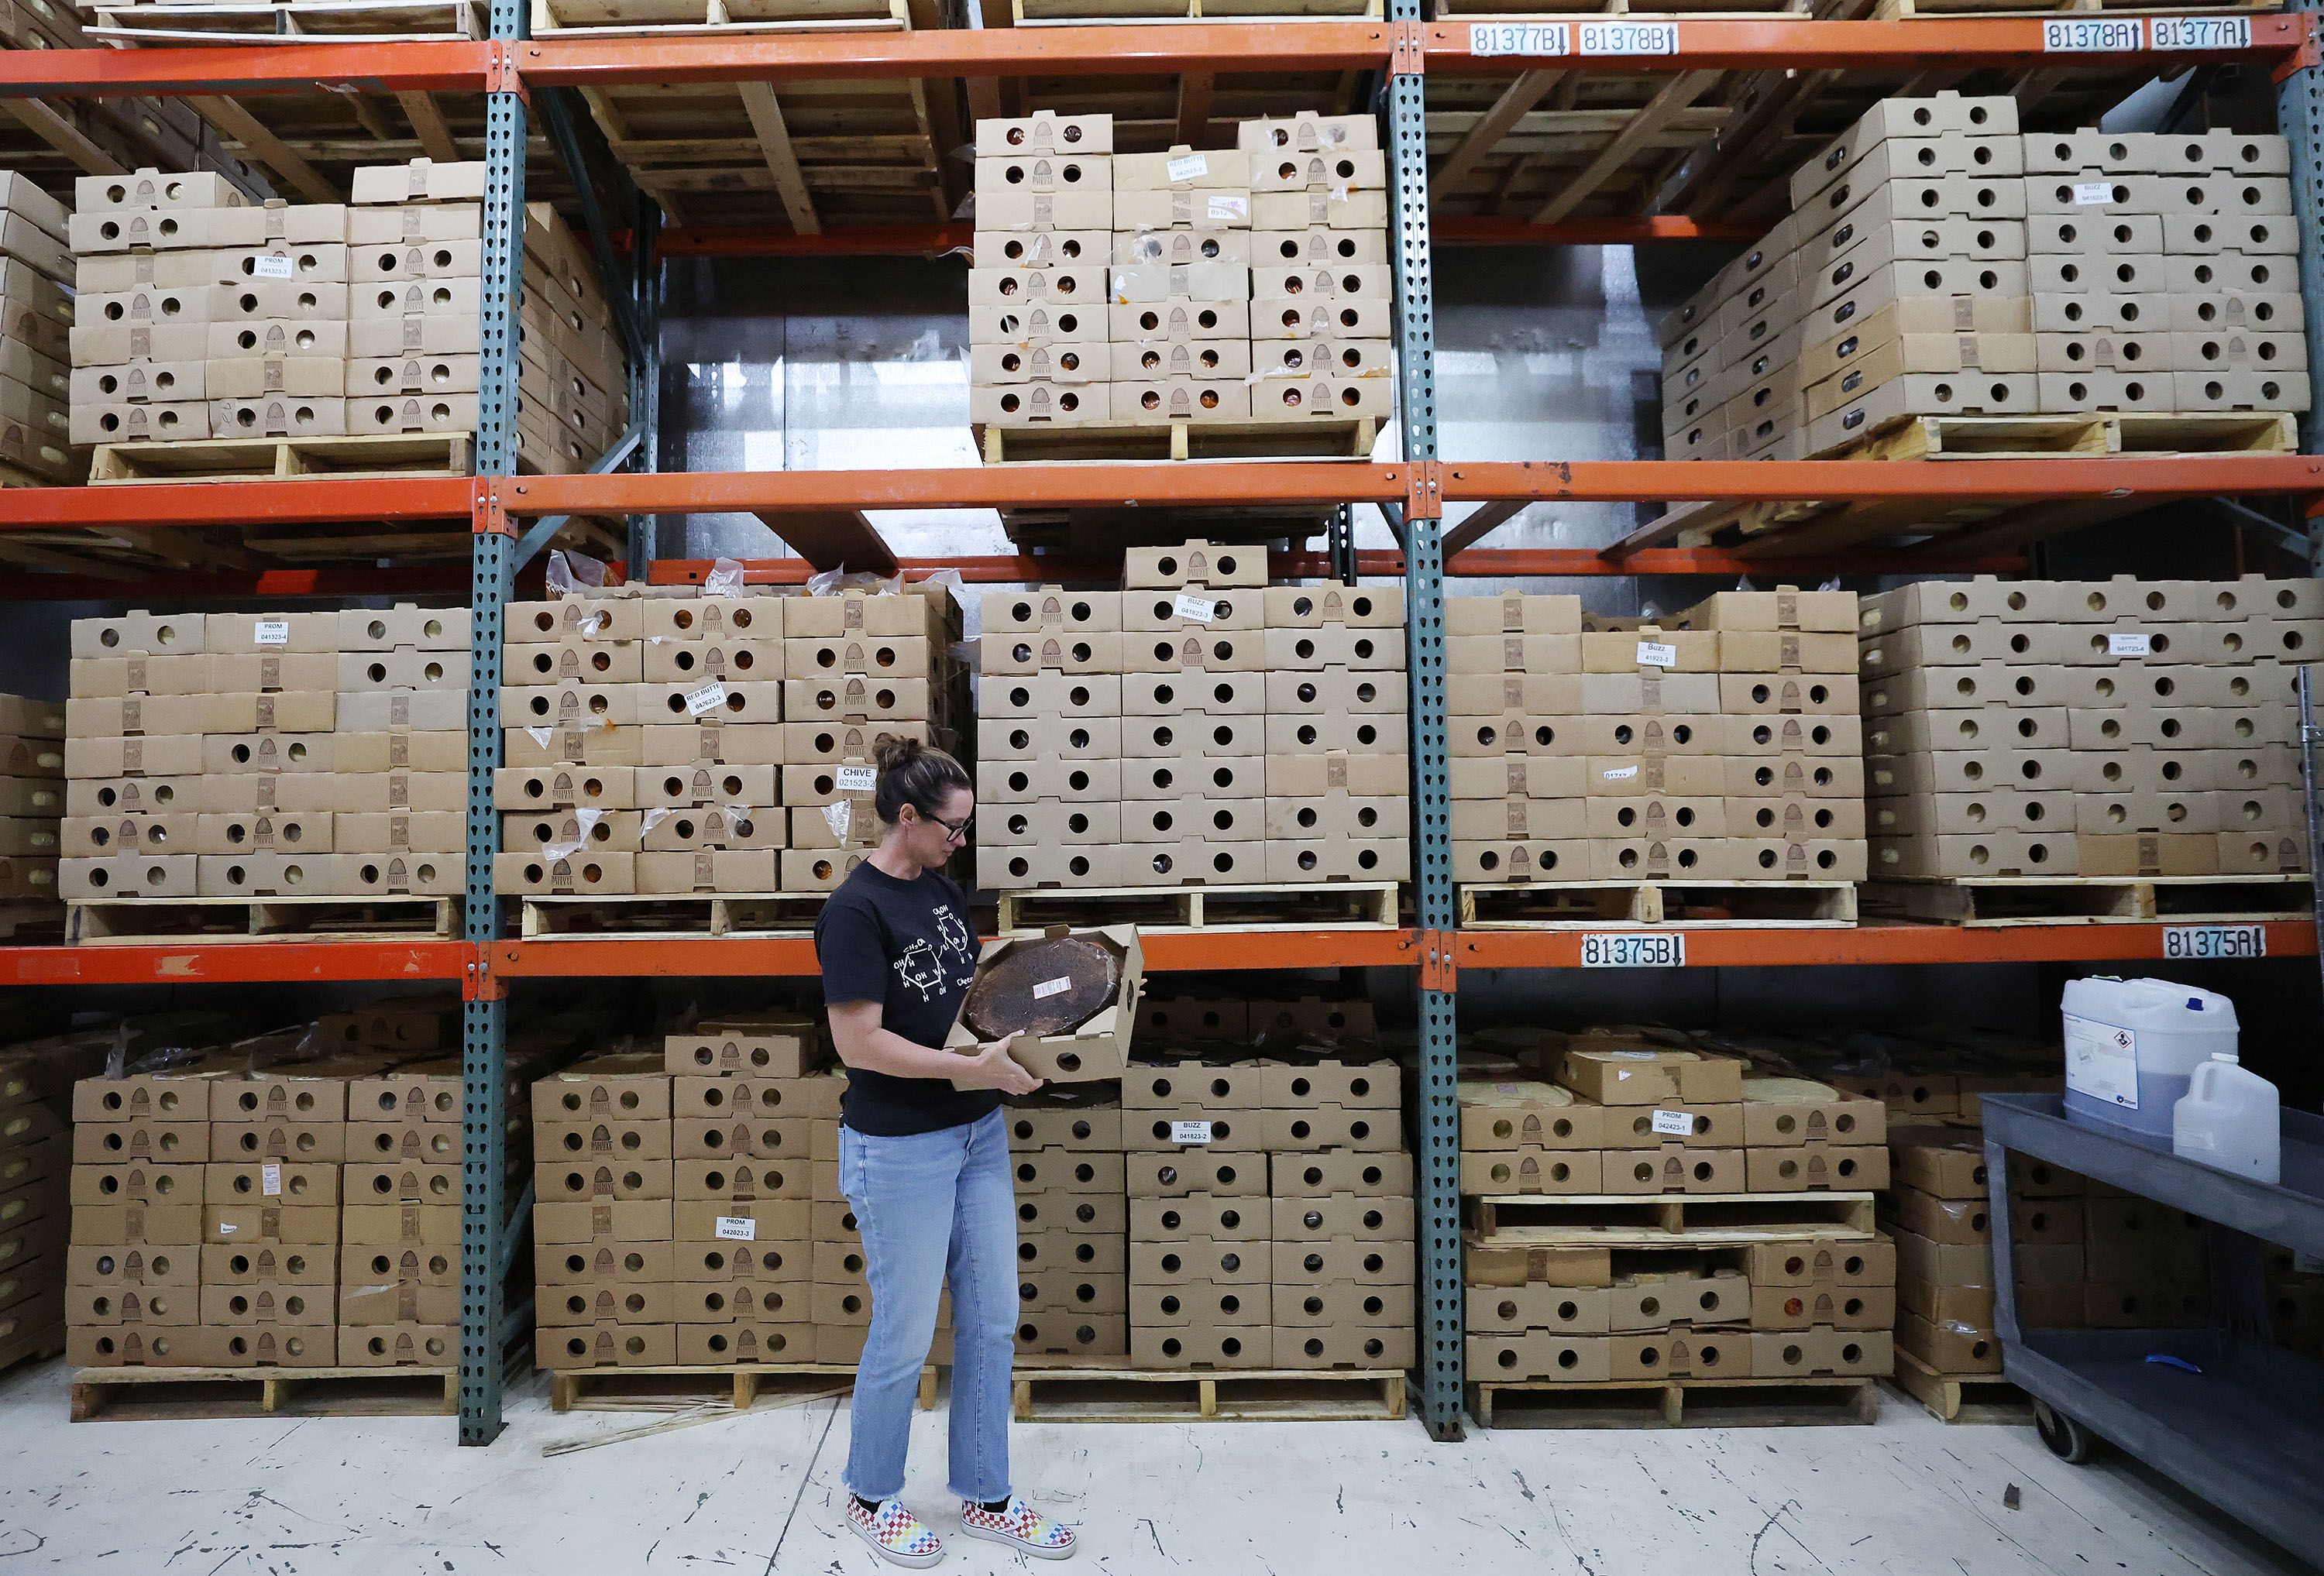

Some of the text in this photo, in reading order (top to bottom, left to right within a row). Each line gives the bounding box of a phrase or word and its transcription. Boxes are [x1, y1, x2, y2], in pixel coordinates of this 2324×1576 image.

[1475, 28, 1554, 51] 81377B
[1584, 28, 1664, 51] 81378B
[2049, 24, 2129, 47] 81378A
[2156, 21, 2236, 46] 81377A
[1188, 597, 1205, 606] BUZZ
[1648, 644, 1666, 652] Buzz
[686, 682, 721, 702] RED BUTTE
[839, 778, 875, 788] 021523-2
[843, 768, 871, 778] CHIVE
[1586, 937, 1669, 964] 81375B
[2168, 930, 2252, 958] 81375A
[1662, 1111, 1682, 1120] PROM
[722, 1228, 750, 1237] 042023-3
